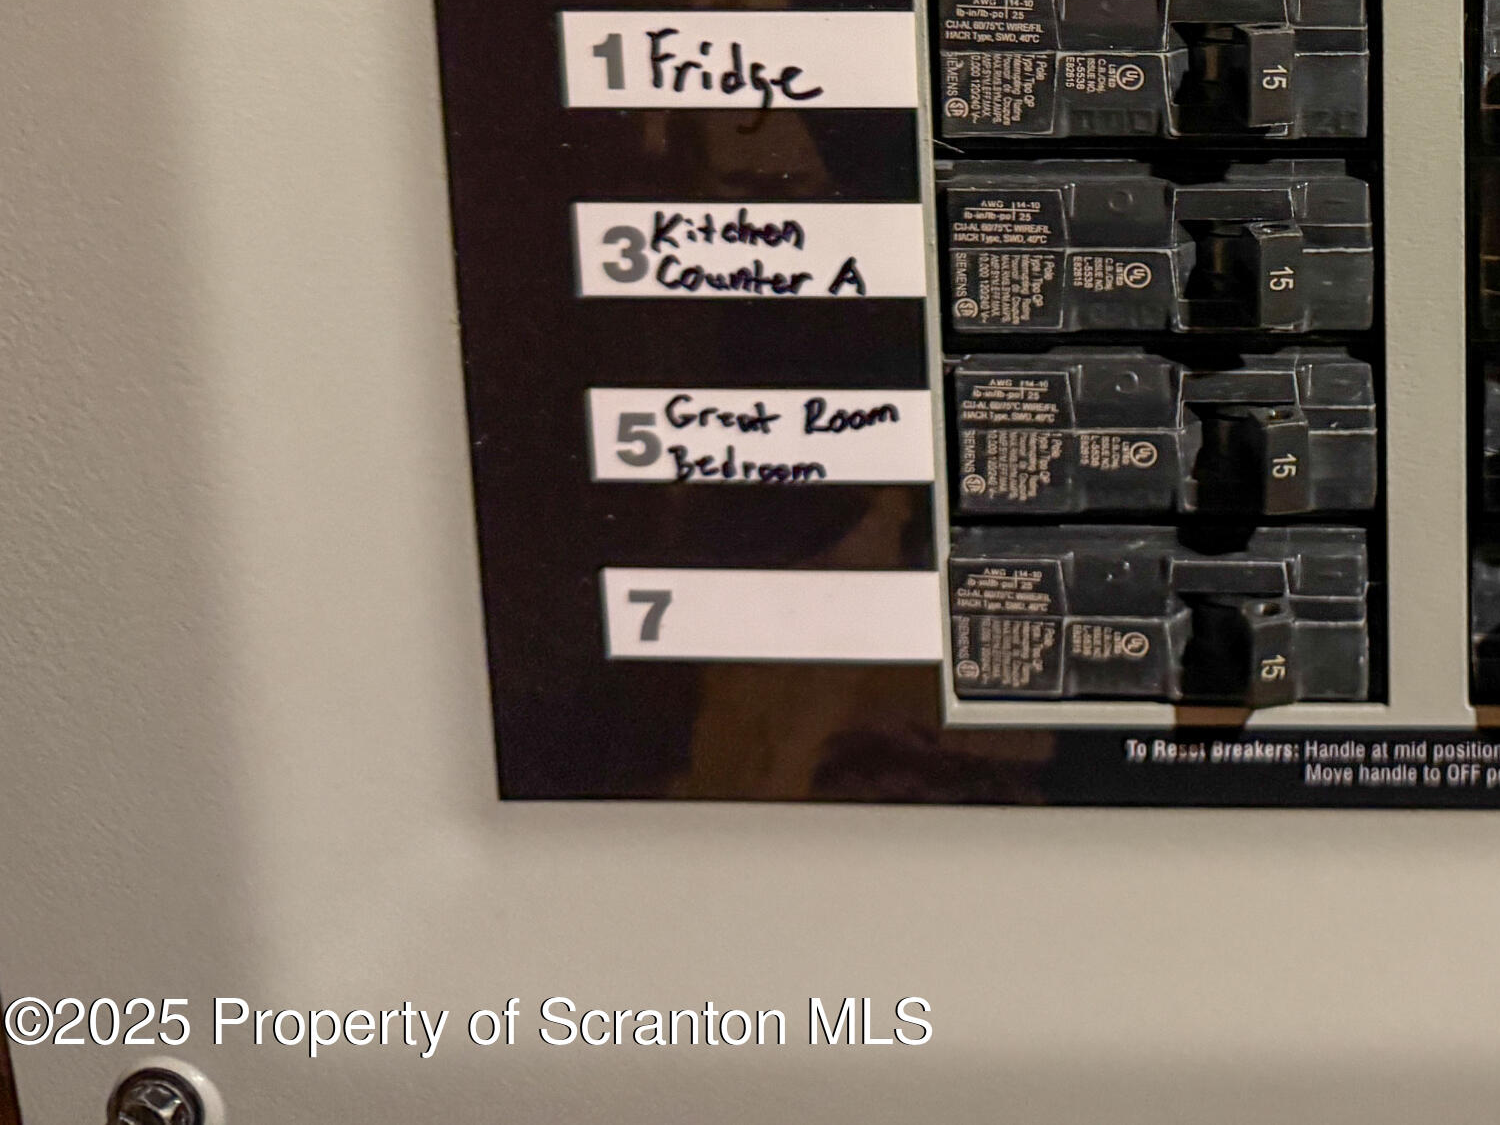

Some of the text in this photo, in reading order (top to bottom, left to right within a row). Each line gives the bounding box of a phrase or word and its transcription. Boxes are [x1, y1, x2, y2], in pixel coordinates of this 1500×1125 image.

[1012, 11, 1025, 20] 25
[592, 33, 626, 90] 1
[1036, 61, 1047, 81] Pole
[1263, 64, 1289, 90] 15
[645, 27, 824, 134] Fridge
[980, 200, 1004, 209] AWG
[1019, 213, 1032, 222] 25
[650, 207, 805, 253] Kitchen
[601, 225, 649, 283] 3
[656, 254, 867, 296] Counter A
[955, 252, 967, 297] SIEMENS
[1269, 265, 1294, 292] 15
[665, 393, 900, 435] Great Room
[615, 412, 662, 467] 5
[667, 443, 827, 483] Bedroom
[1271, 453, 1297, 478] 15
[628, 589, 672, 642] 7
[1261, 654, 1287, 681] 15
[1126, 739, 1147, 760] To
[1211, 740, 1299, 761] Breakers:
[1304, 740, 1366, 761] Handle
[1371, 741, 1388, 761] at
[1394, 740, 1427, 761] mid
[1304, 764, 1353, 783] Move
[1358, 763, 1418, 783] handle
[1423, 764, 1442, 783] to
[1447, 764, 1481, 783] OFF
